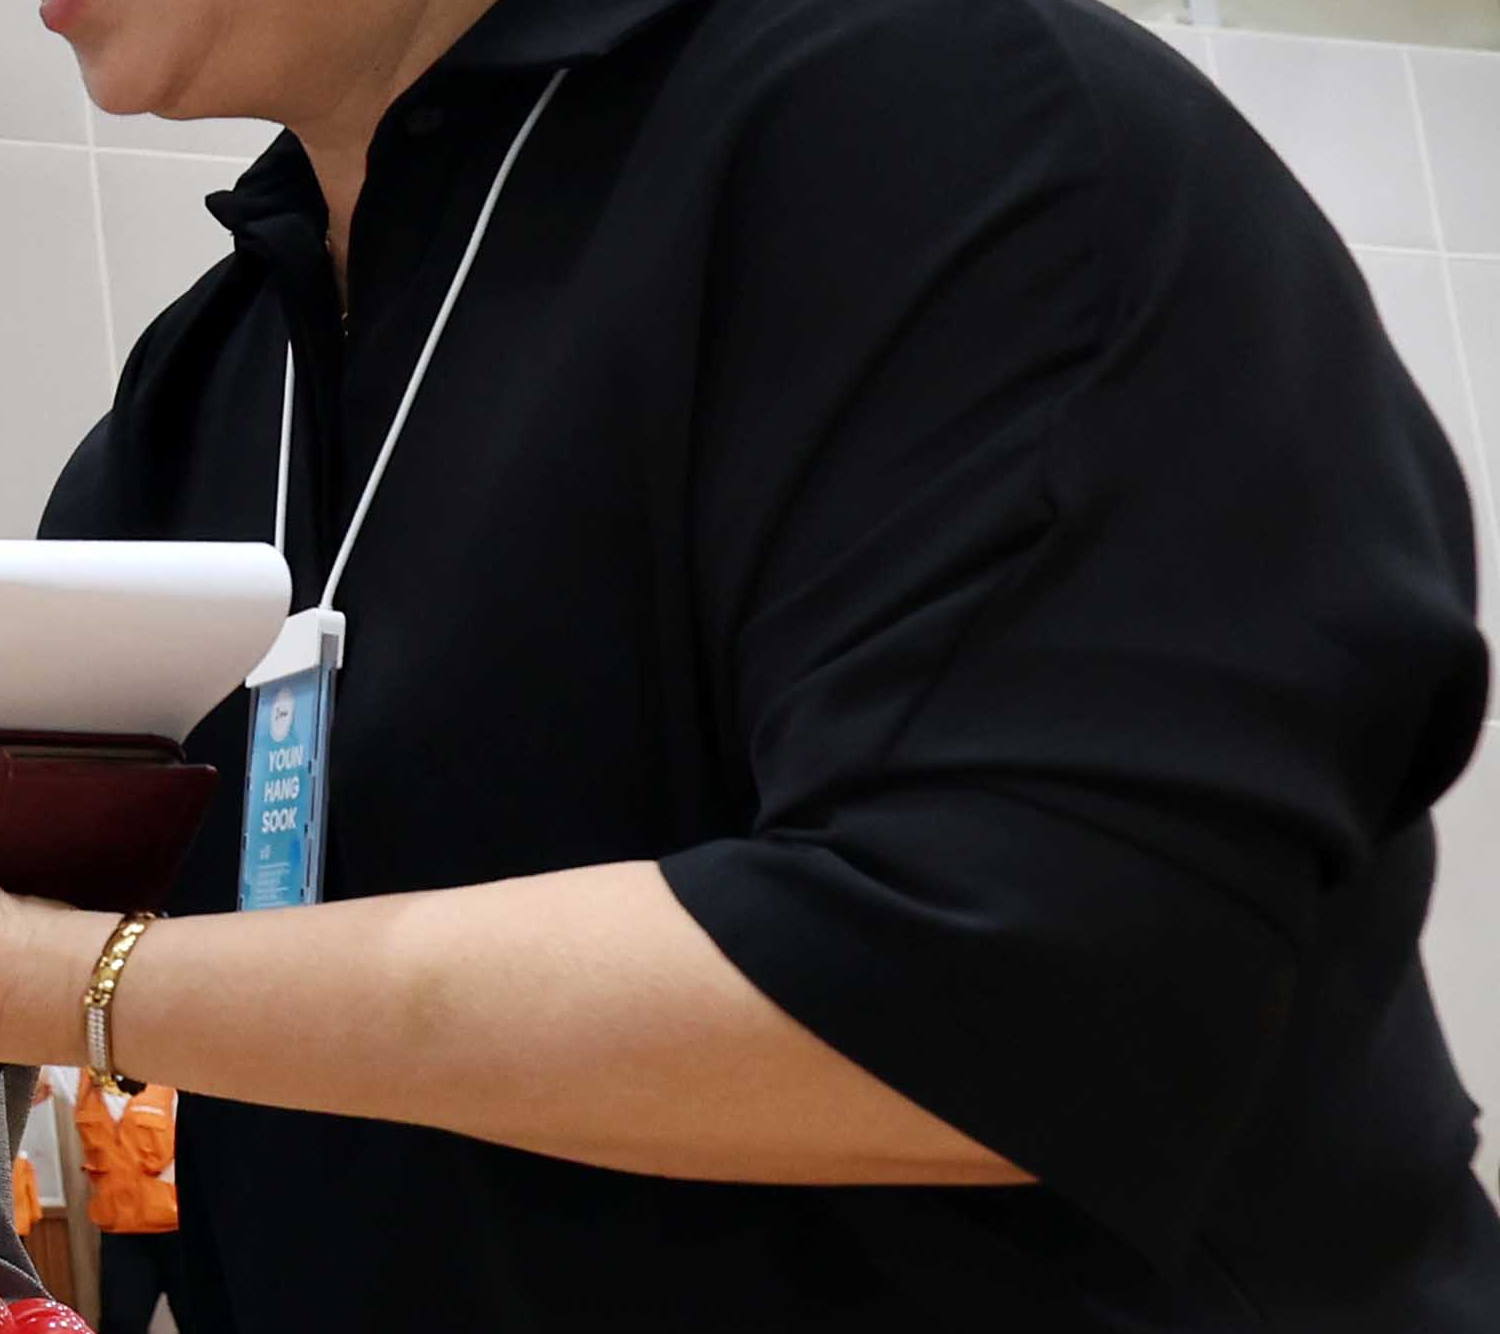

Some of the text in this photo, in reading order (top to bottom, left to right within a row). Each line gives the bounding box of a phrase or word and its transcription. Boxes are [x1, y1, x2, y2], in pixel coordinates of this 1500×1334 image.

[268, 745, 304, 772] YOUN
[264, 776, 300, 803] HANG
[261, 807, 298, 833] SOOK
